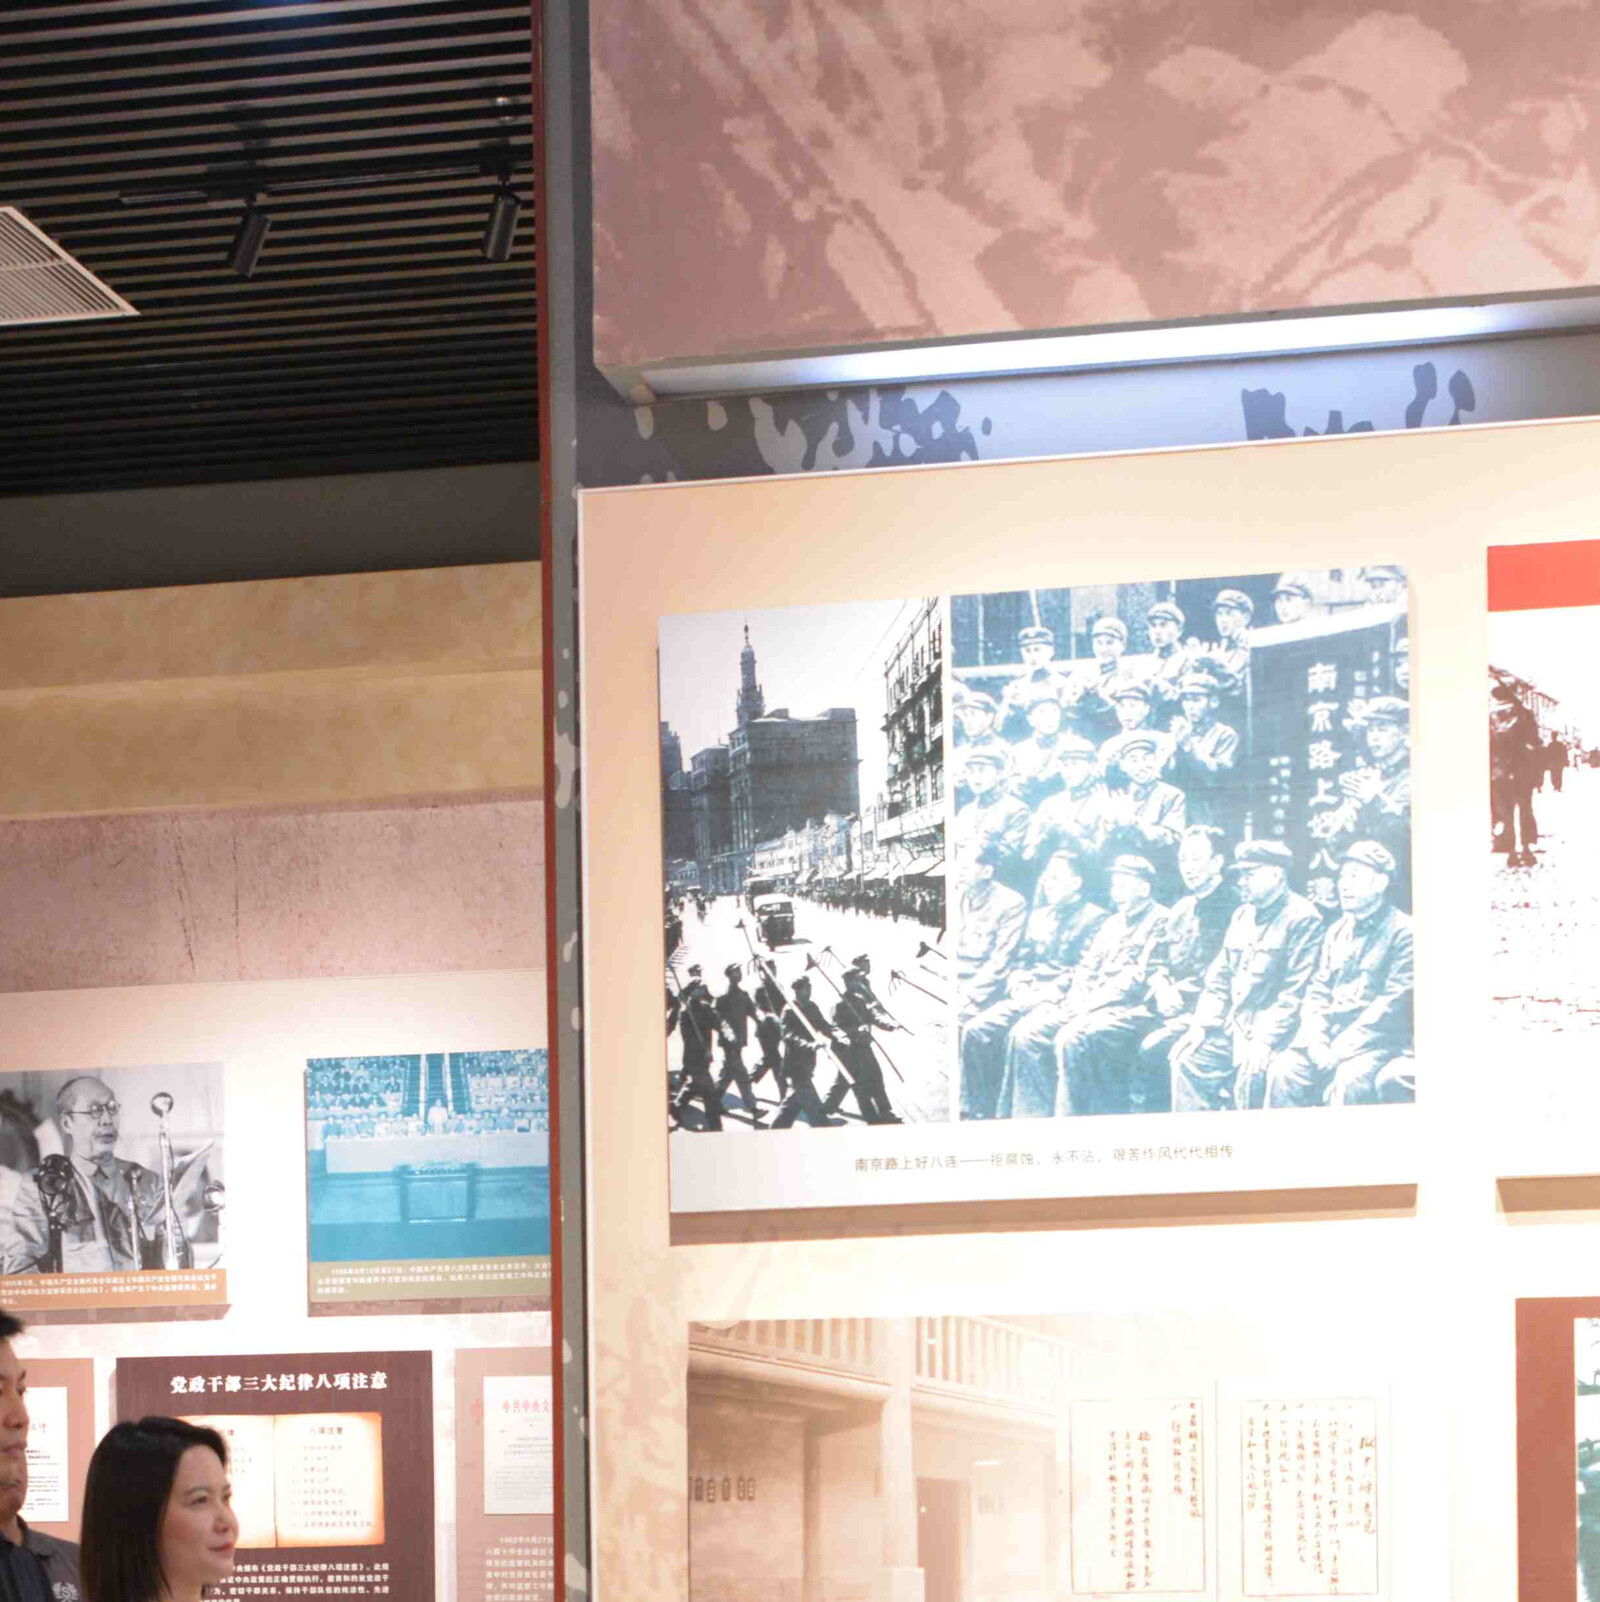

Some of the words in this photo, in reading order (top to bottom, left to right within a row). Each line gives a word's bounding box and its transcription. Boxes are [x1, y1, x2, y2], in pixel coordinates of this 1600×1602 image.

[170, 1370, 388, 1394] 党政干部三大纪律八项注意
